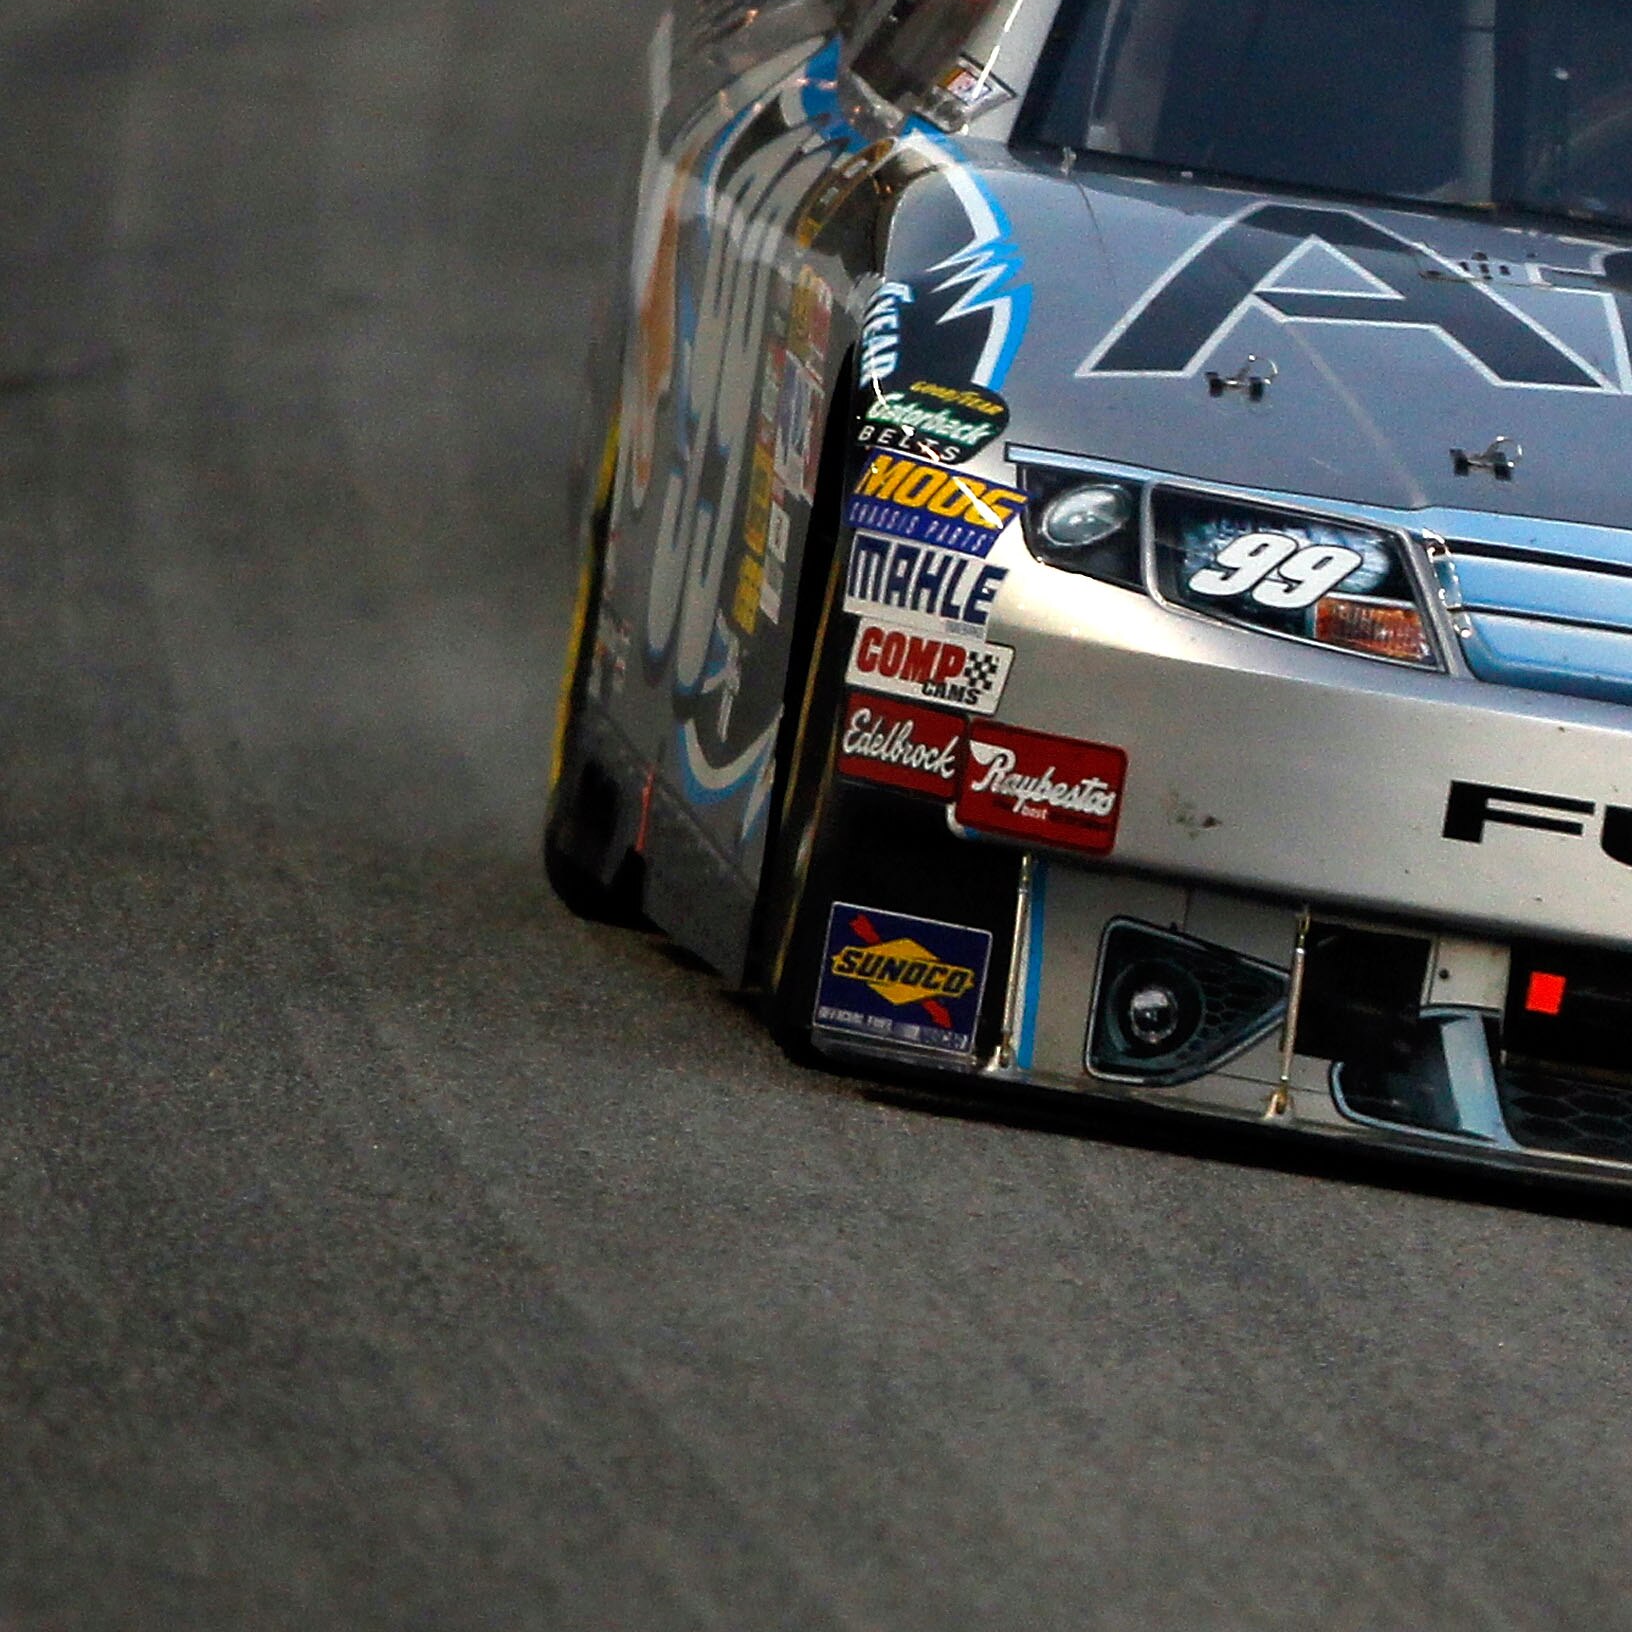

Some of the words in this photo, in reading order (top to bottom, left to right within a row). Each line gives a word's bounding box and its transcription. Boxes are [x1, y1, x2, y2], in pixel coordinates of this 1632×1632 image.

[857, 424, 961, 461] BELTS
[853, 453, 1029, 530] MOOG
[848, 532, 1009, 626] MAHLE
[1188, 531, 1363, 609] 99
[856, 625, 968, 685] COMP
[921, 680, 982, 705] CAMS
[841, 707, 960, 779] Edelbrock
[970, 739, 1117, 817] Raybestos
[834, 948, 970, 993] SUNOCO
